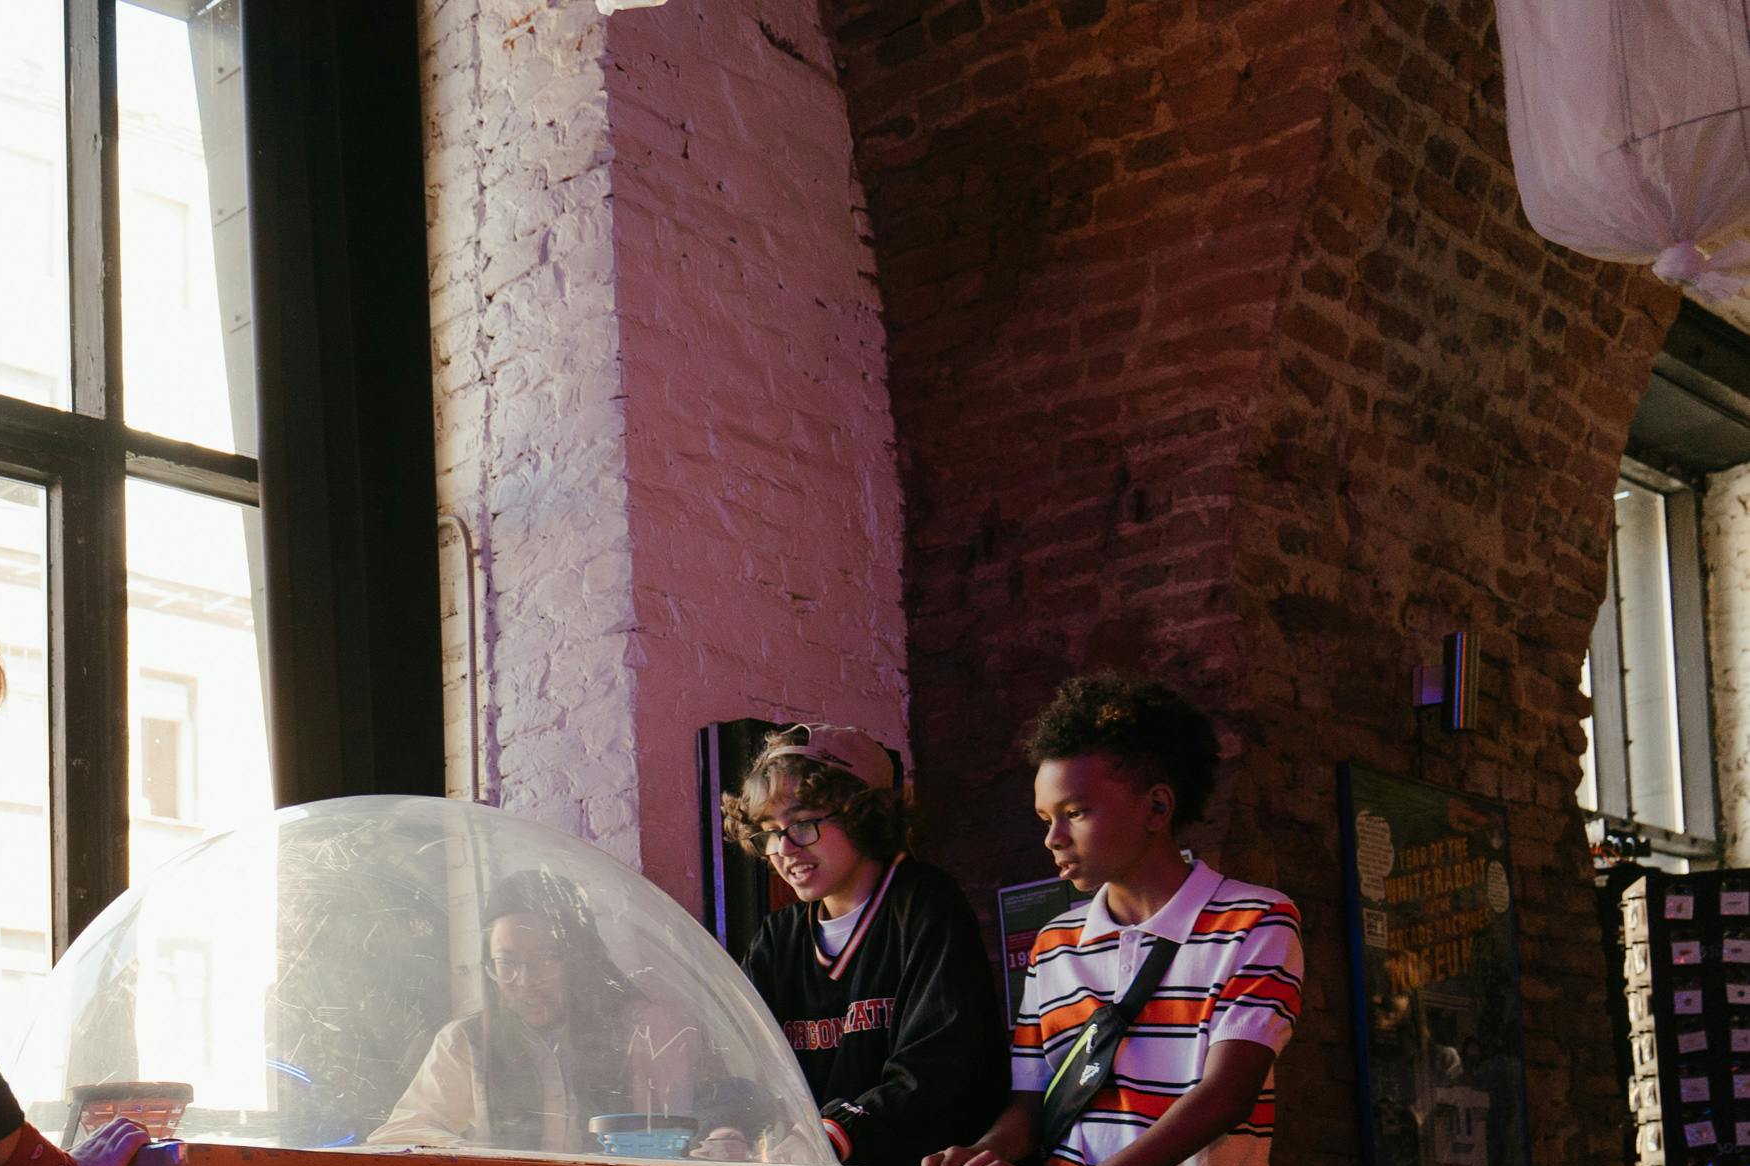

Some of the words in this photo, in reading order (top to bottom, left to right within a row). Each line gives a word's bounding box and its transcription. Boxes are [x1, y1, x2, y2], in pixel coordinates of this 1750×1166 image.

[1384, 869, 1431, 904] WHITE
[1433, 856, 1487, 893] RABBIT
[783, 1016, 847, 1050] ORGON
